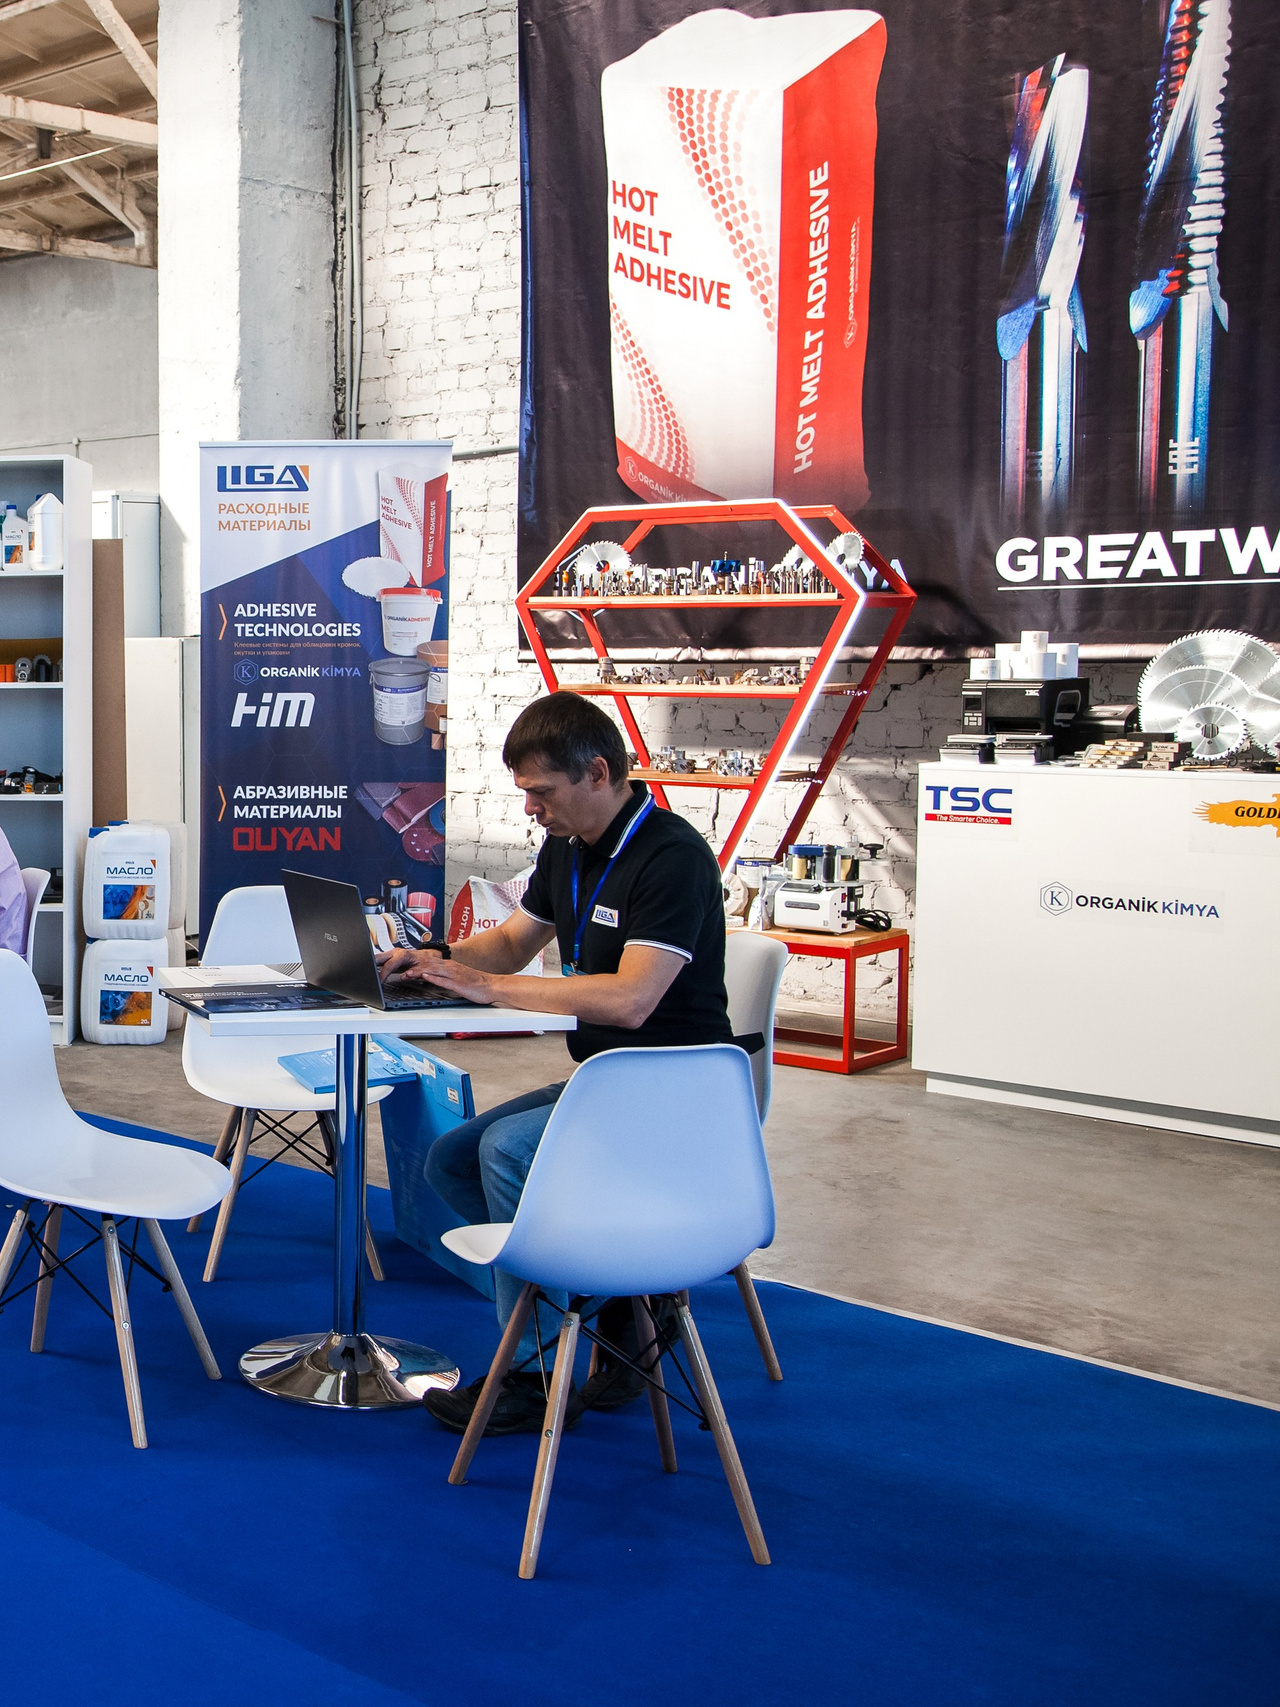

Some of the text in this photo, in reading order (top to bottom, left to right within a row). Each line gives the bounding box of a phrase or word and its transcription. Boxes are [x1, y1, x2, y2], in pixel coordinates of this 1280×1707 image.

[612, 180, 658, 216] HOT
[613, 215, 672, 257] MELT
[614, 252, 731, 310] ADHESIVE
[794, 161, 829, 474] HOT MELT ADHESIVE
[217, 465, 308, 492] LIGA
[381, 496, 393, 505] HOT
[218, 503, 309, 516] РАСХОДНЫЕ
[381, 504, 397, 515] MELT
[218, 520, 311, 531] МАТЕРИАЛЫ
[381, 513, 412, 530] ADHESIVE
[996, 525, 1280, 582] GREATW
[234, 603, 317, 617] ADHESIVE
[234, 623, 361, 637] TECHNOLOGIES
[260, 665, 319, 677] ORGANİK
[321, 665, 361, 677] KİMYA
[233, 785, 348, 799] АБРАЗИВНЫЕ
[926, 785, 1012, 814] TSC
[233, 805, 341, 818] МАТЕРИАЛЫ
[936, 814, 947, 822] The
[948, 814, 975, 823] Smarter
[233, 827, 341, 850] OUYAN
[106, 866, 154, 875] МАСЛО
[1075, 894, 1159, 914] ORGANİK
[1162, 899, 1220, 918] KİMYA
[461, 906, 471, 928] HOT
[474, 918, 498, 929] HOT
[104, 973, 149, 983] МАСЛО
